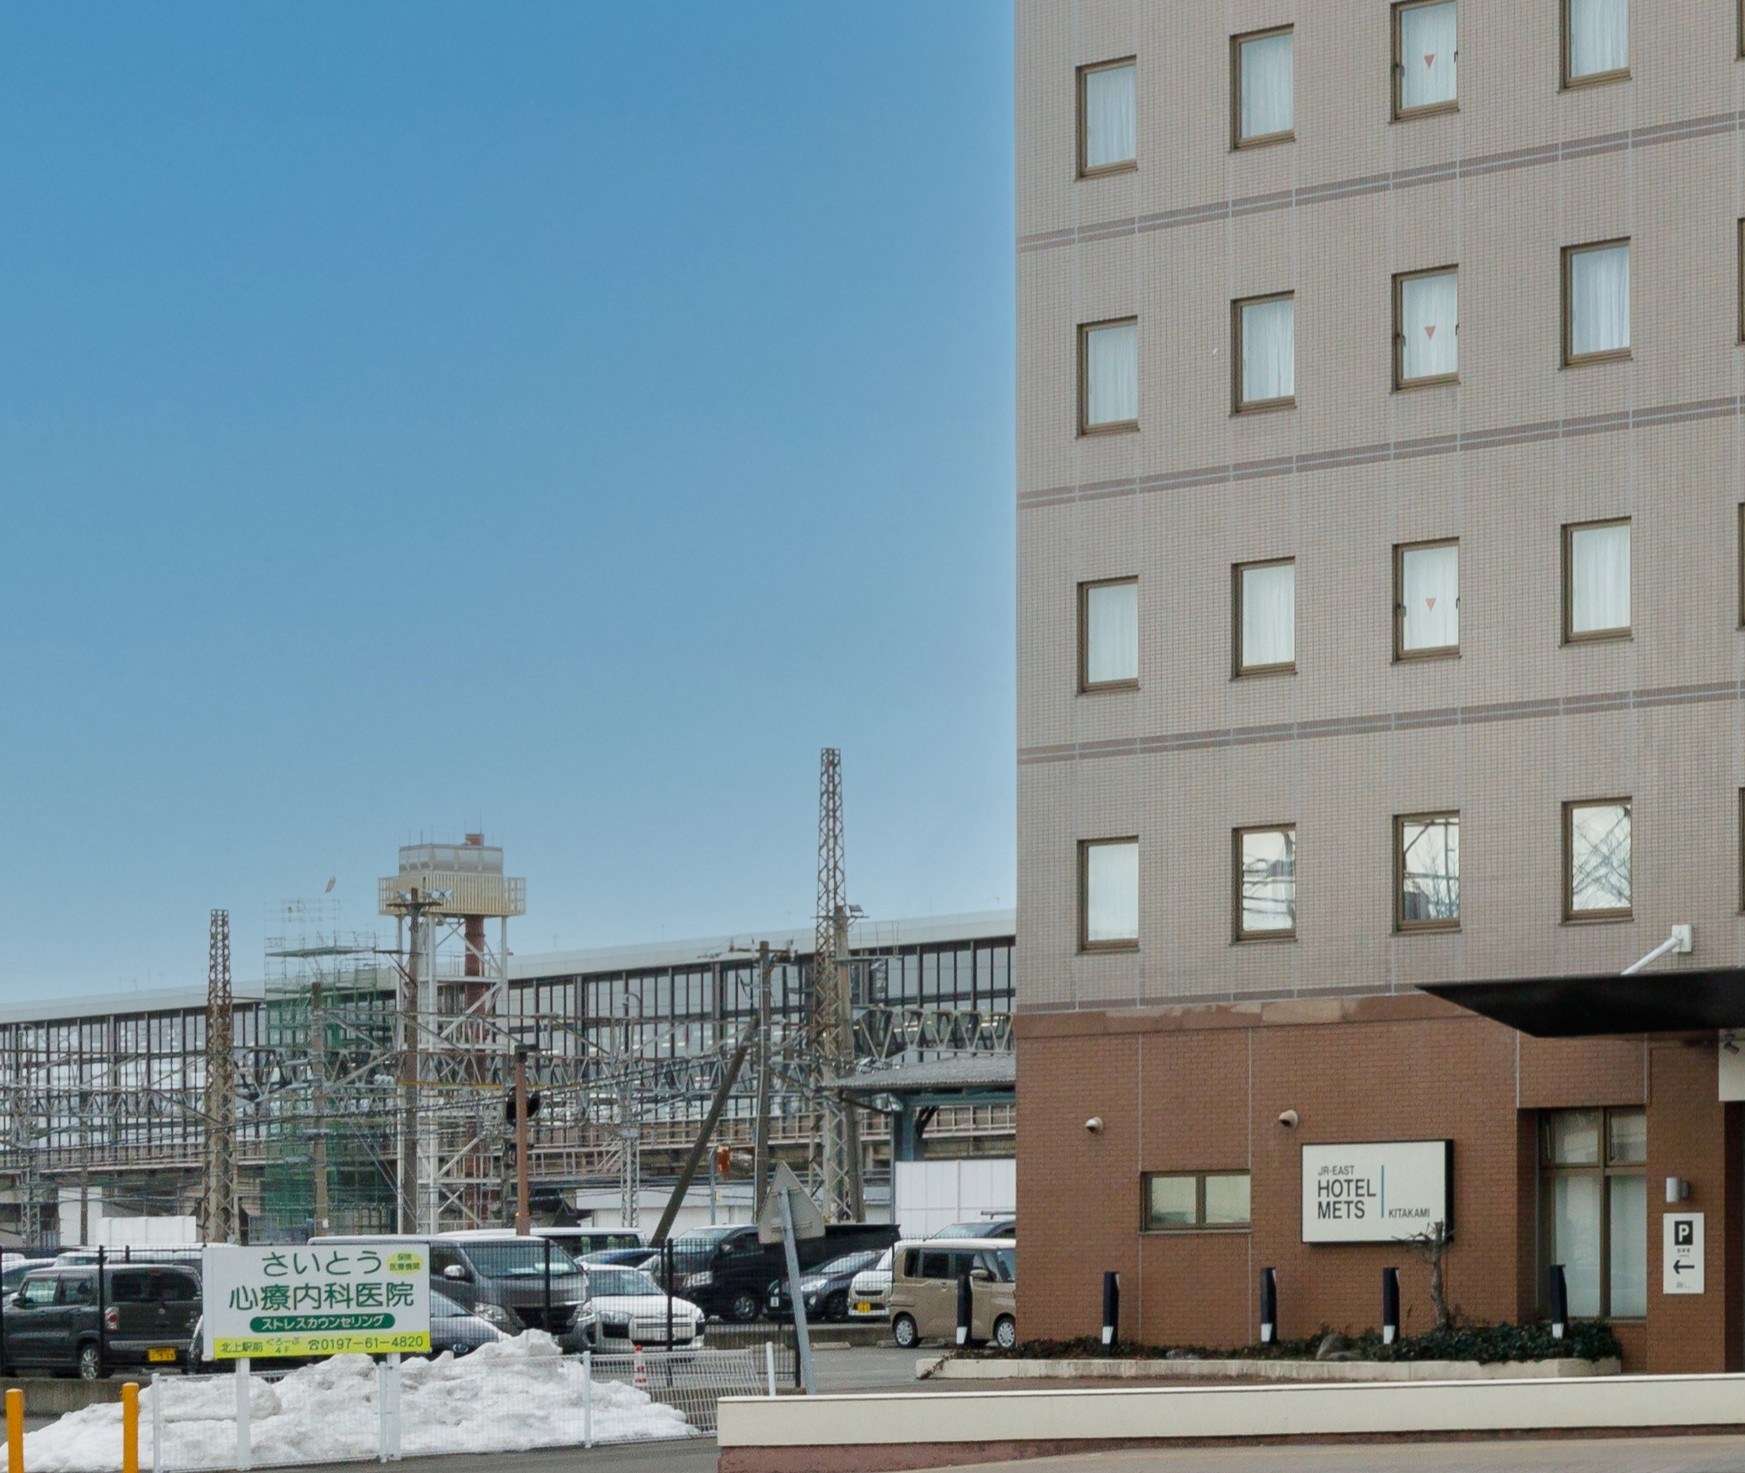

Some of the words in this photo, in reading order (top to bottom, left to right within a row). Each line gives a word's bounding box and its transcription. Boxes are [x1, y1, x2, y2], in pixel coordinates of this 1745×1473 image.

[1318, 1165, 1355, 1176] JR-EAST
[1317, 1179, 1377, 1198] HOTEL
[1317, 1200, 1366, 1220] METS
[1388, 1208, 1431, 1219] KITAKAMI
[1678, 1224, 1690, 1243] P
[261, 1250, 382, 1276] さいとう
[228, 1281, 415, 1311] 心療内科医院
[261, 1314, 384, 1330] ストレスカウンセリング
